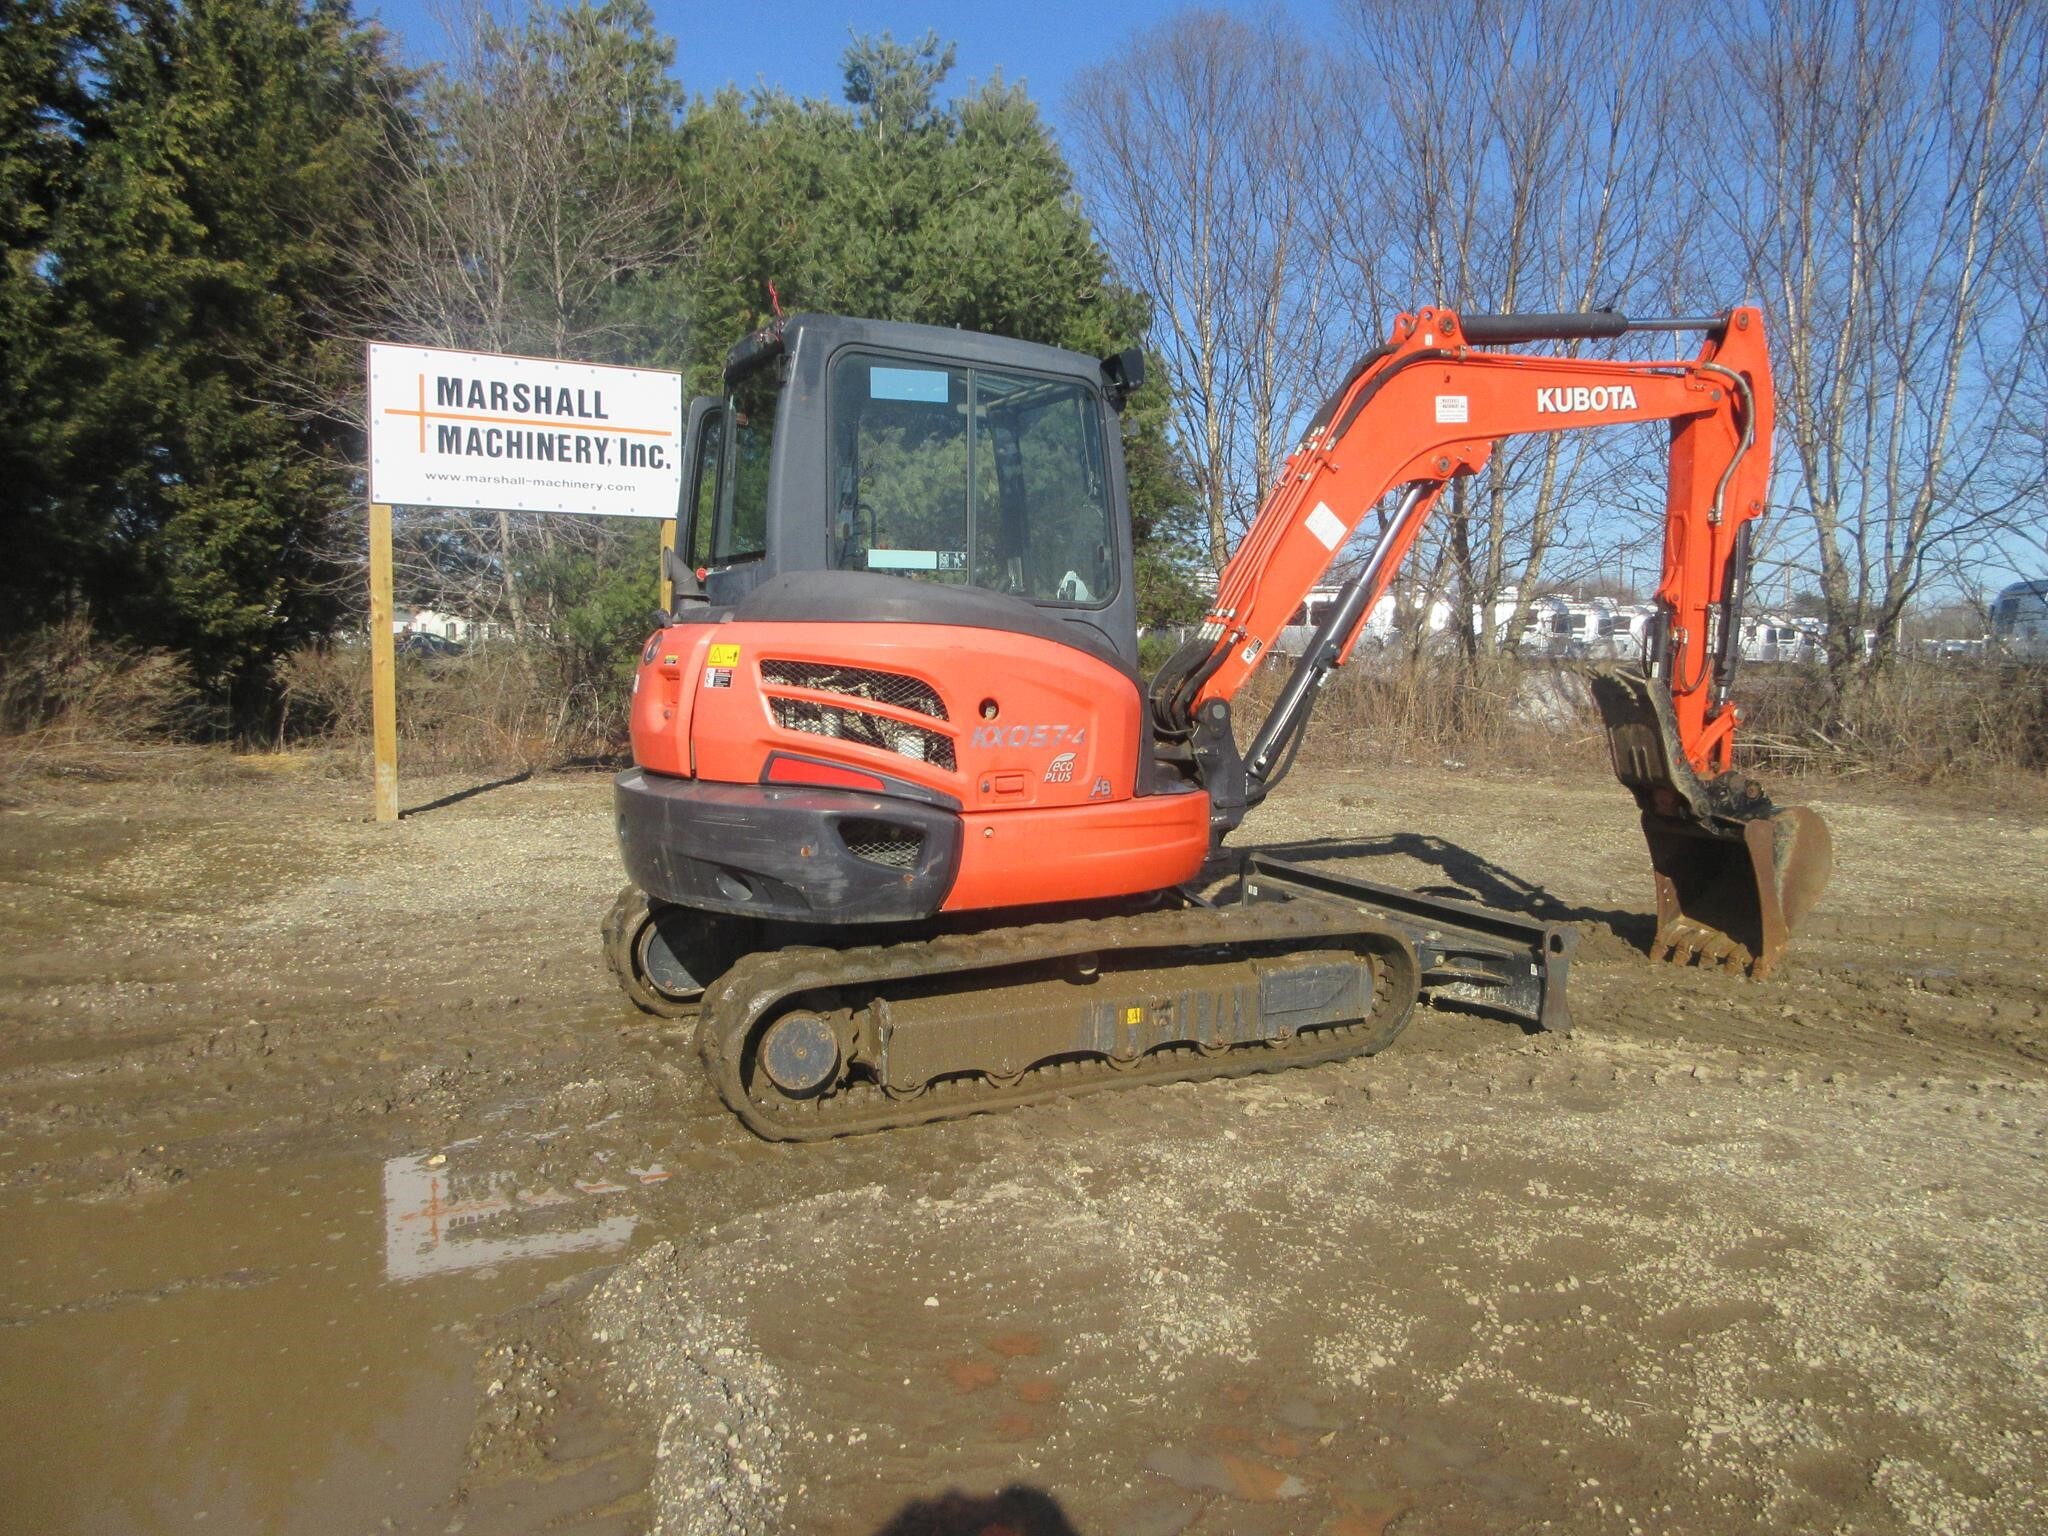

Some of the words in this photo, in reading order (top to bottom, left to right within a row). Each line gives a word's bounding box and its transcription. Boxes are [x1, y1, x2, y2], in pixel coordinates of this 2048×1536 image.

[437, 376, 609, 420] MARSHALL
[1536, 385, 1638, 413] KUBOTA
[437, 424, 613, 467] MACHINERY,
[619, 437, 671, 470] Inc.
[425, 471, 636, 492] www.marshall-machinery.com
[970, 725, 1086, 748] KX057-4
[1043, 771, 1072, 783] PLUS
[1052, 761, 1074, 772] eco
